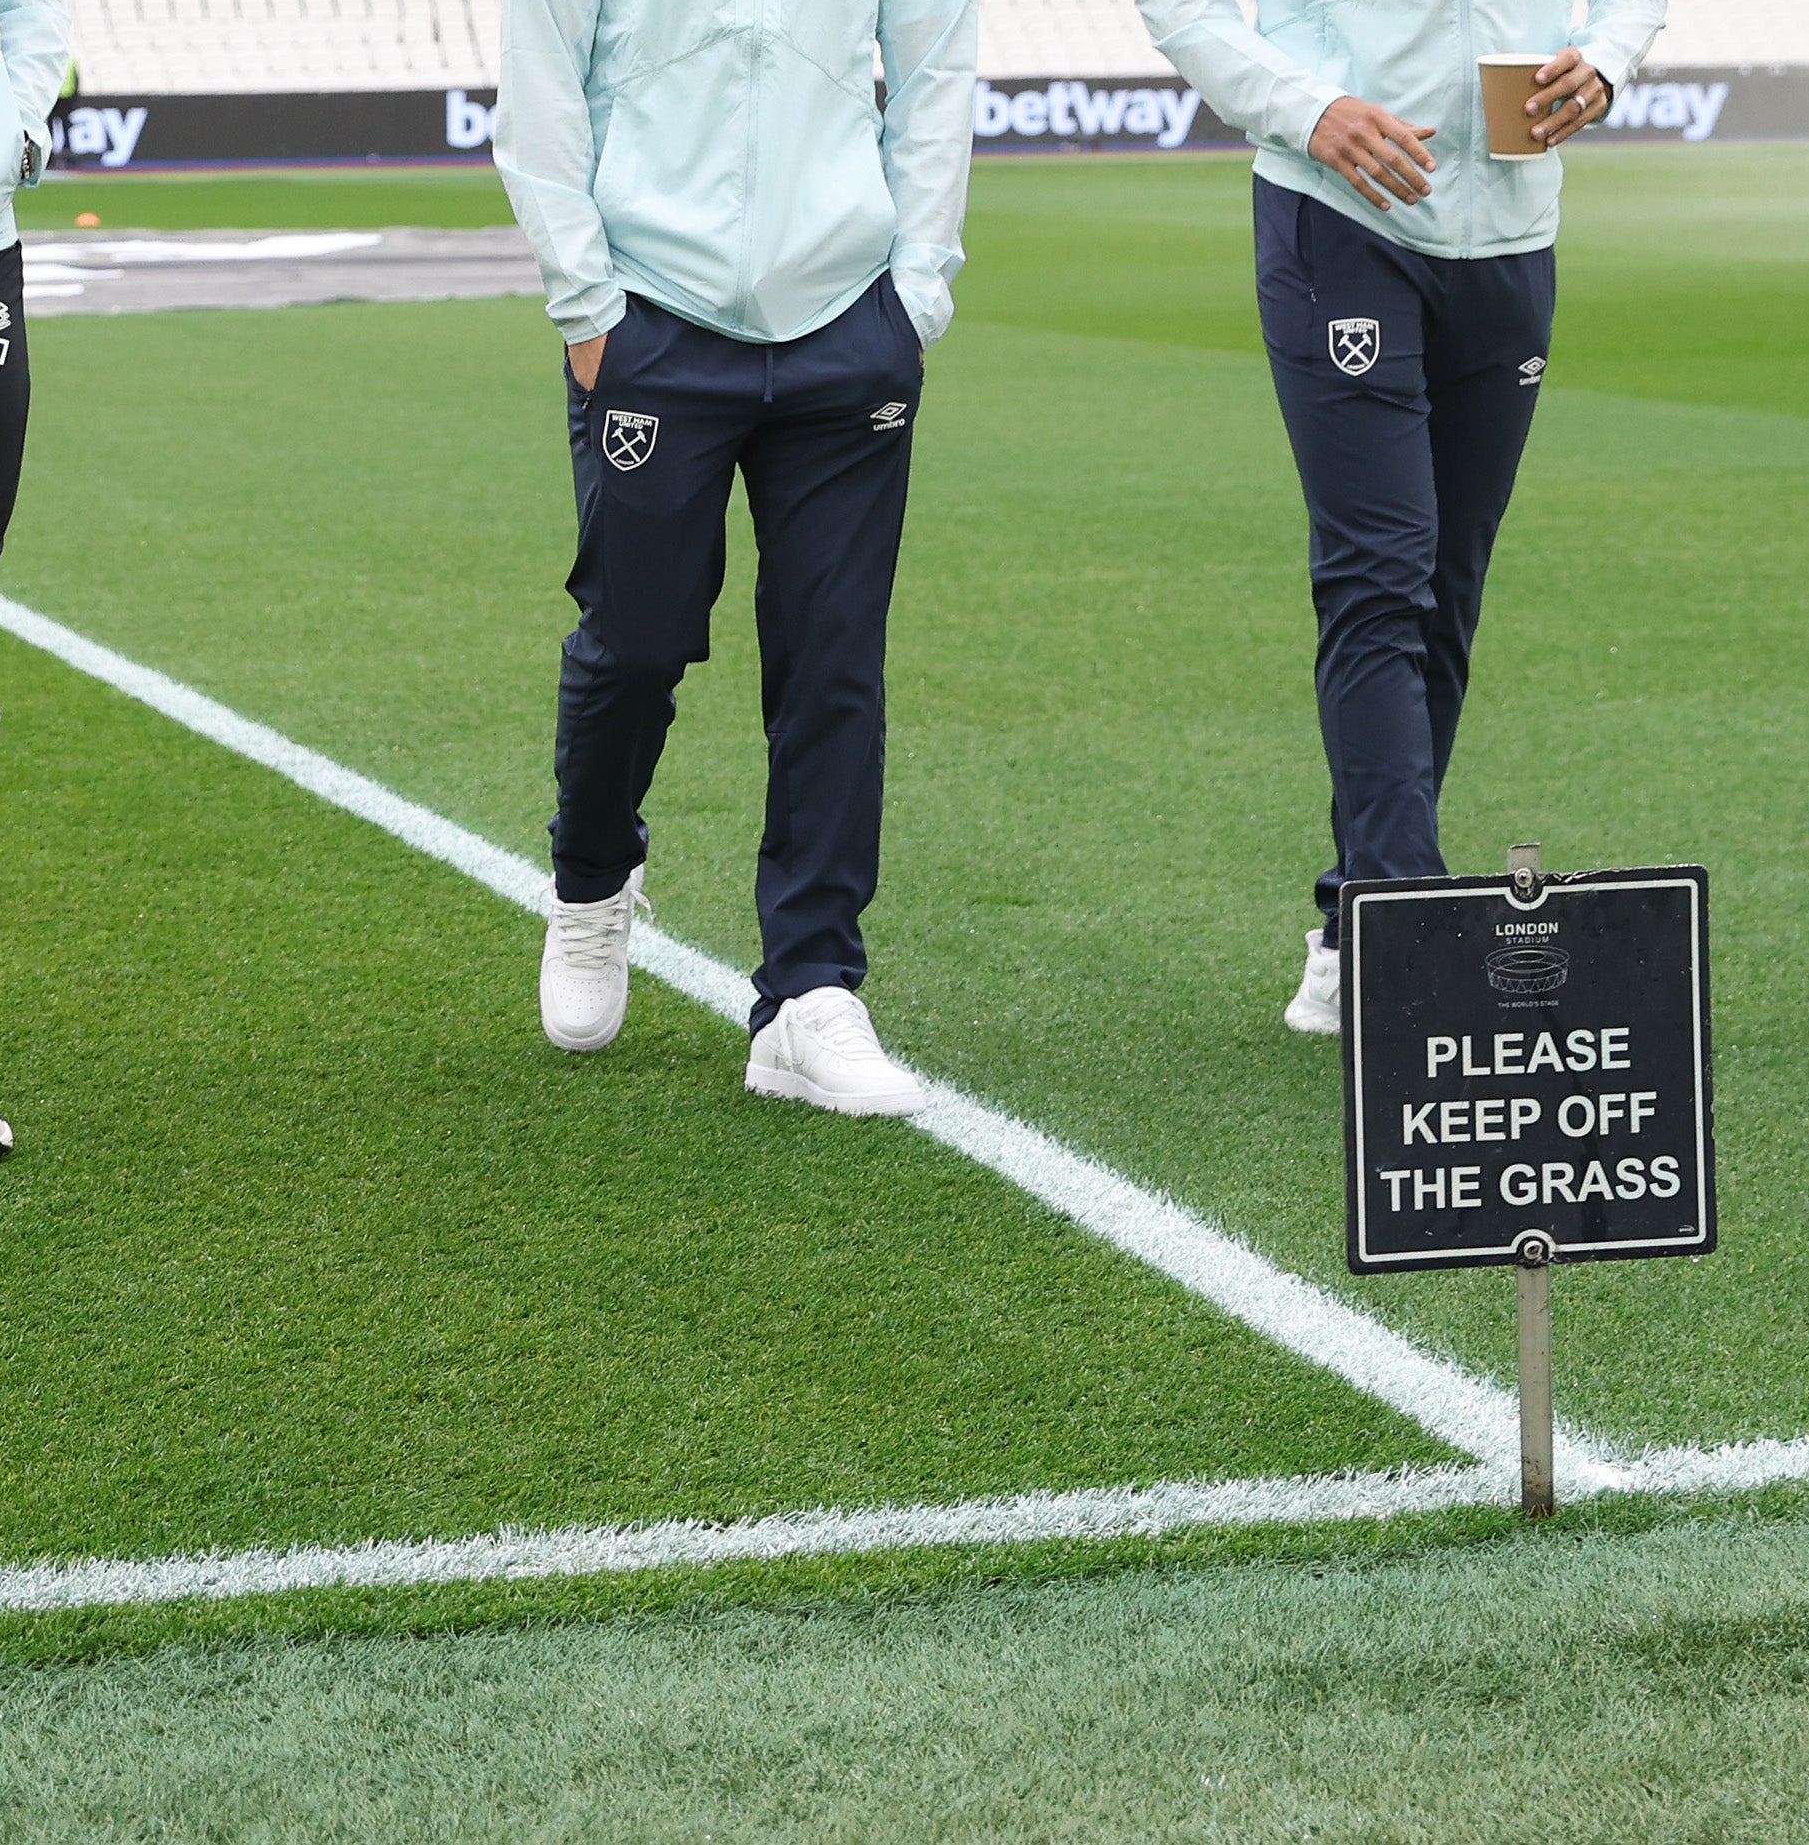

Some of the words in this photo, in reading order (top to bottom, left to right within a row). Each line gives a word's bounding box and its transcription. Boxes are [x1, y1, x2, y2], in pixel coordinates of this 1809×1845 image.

[973, 80, 1199, 148] betway
[612, 414, 632, 423] WEST
[633, 417, 653, 427] HAM
[873, 418, 906, 432] umbro
[1495, 922, 1559, 936] LONDON
[1506, 936, 1549, 945] STADIUM
[1498, 1001, 1510, 1009] THE
[1540, 999, 1560, 1007] STAGE
[1426, 1027, 1632, 1078] PLEASE
[1402, 1098, 1542, 1146] KEEP
[1557, 1091, 1658, 1138] OFF
[1379, 1165, 1483, 1212] THE
[1499, 1155, 1682, 1207] GRASS
